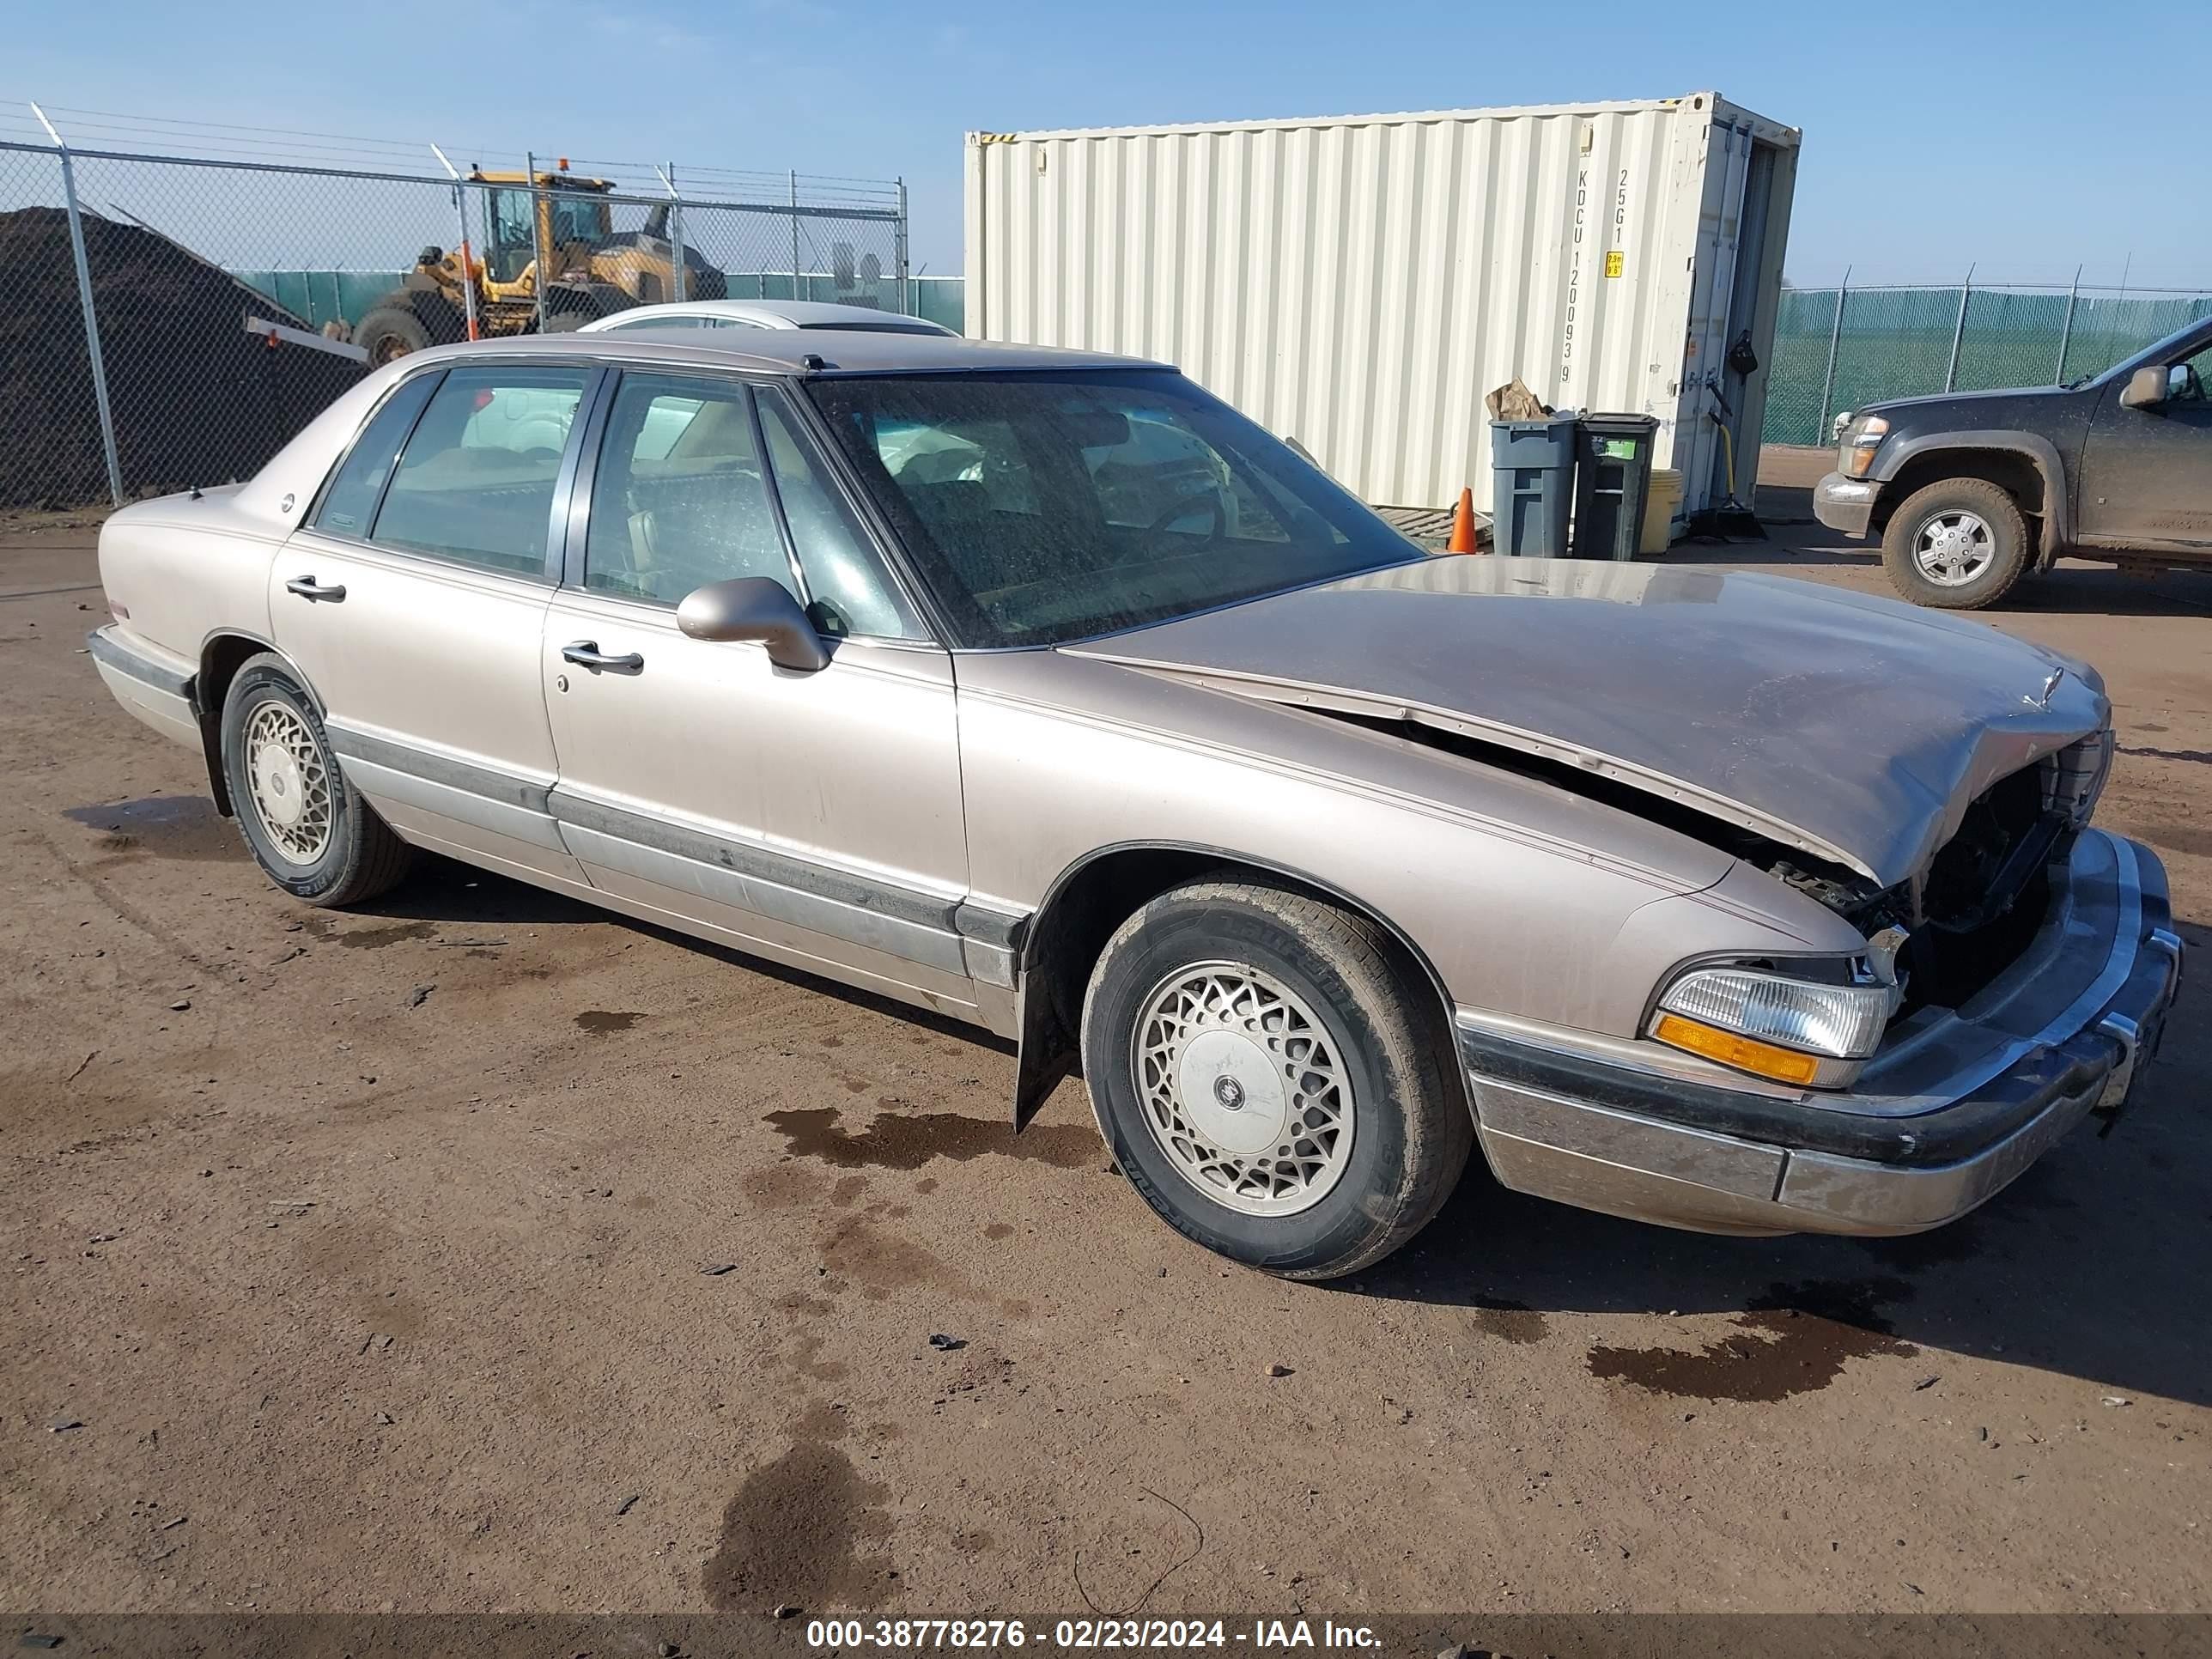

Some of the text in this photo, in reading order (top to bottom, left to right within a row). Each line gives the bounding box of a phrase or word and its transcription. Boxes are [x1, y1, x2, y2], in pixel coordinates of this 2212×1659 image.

[1562, 170, 1588, 382] KDCU 120093 9
[1615, 169, 1628, 243] 25G1
